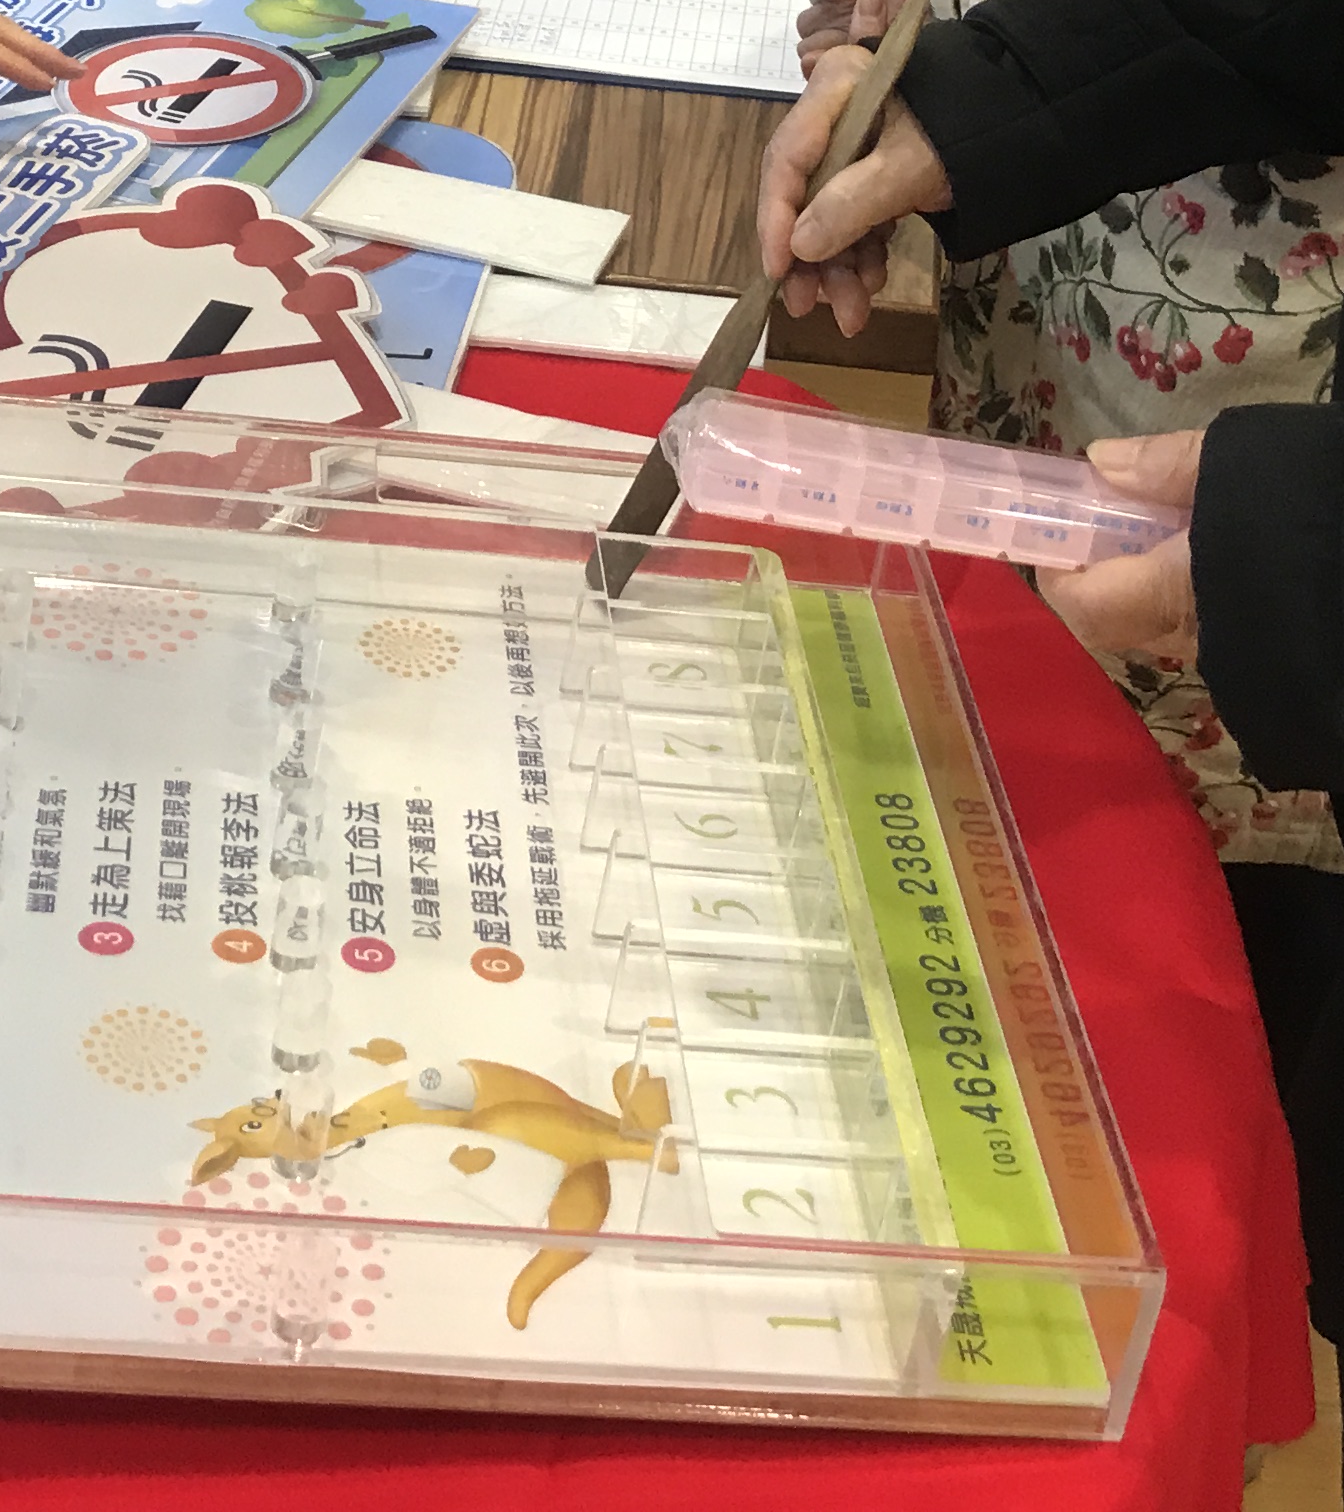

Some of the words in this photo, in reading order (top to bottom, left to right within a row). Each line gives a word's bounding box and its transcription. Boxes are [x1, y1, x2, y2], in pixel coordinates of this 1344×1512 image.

[647, 661, 709, 684] 8
[663, 730, 724, 758] 7
[691, 812, 740, 841] 6
[875, 790, 939, 897] 23808
[88, 780, 138, 919] 走為上策法
[217, 791, 261, 928] 投桃報李法
[343, 800, 388, 936] 安身立命法
[463, 807, 512, 948] 虛與委蛇法
[691, 895, 758, 927] 5
[921, 904, 962, 945] 分機
[704, 986, 773, 1022] 4
[724, 1086, 800, 1117] 3
[741, 1188, 817, 1226] 2
[766, 1315, 844, 1335] 1
